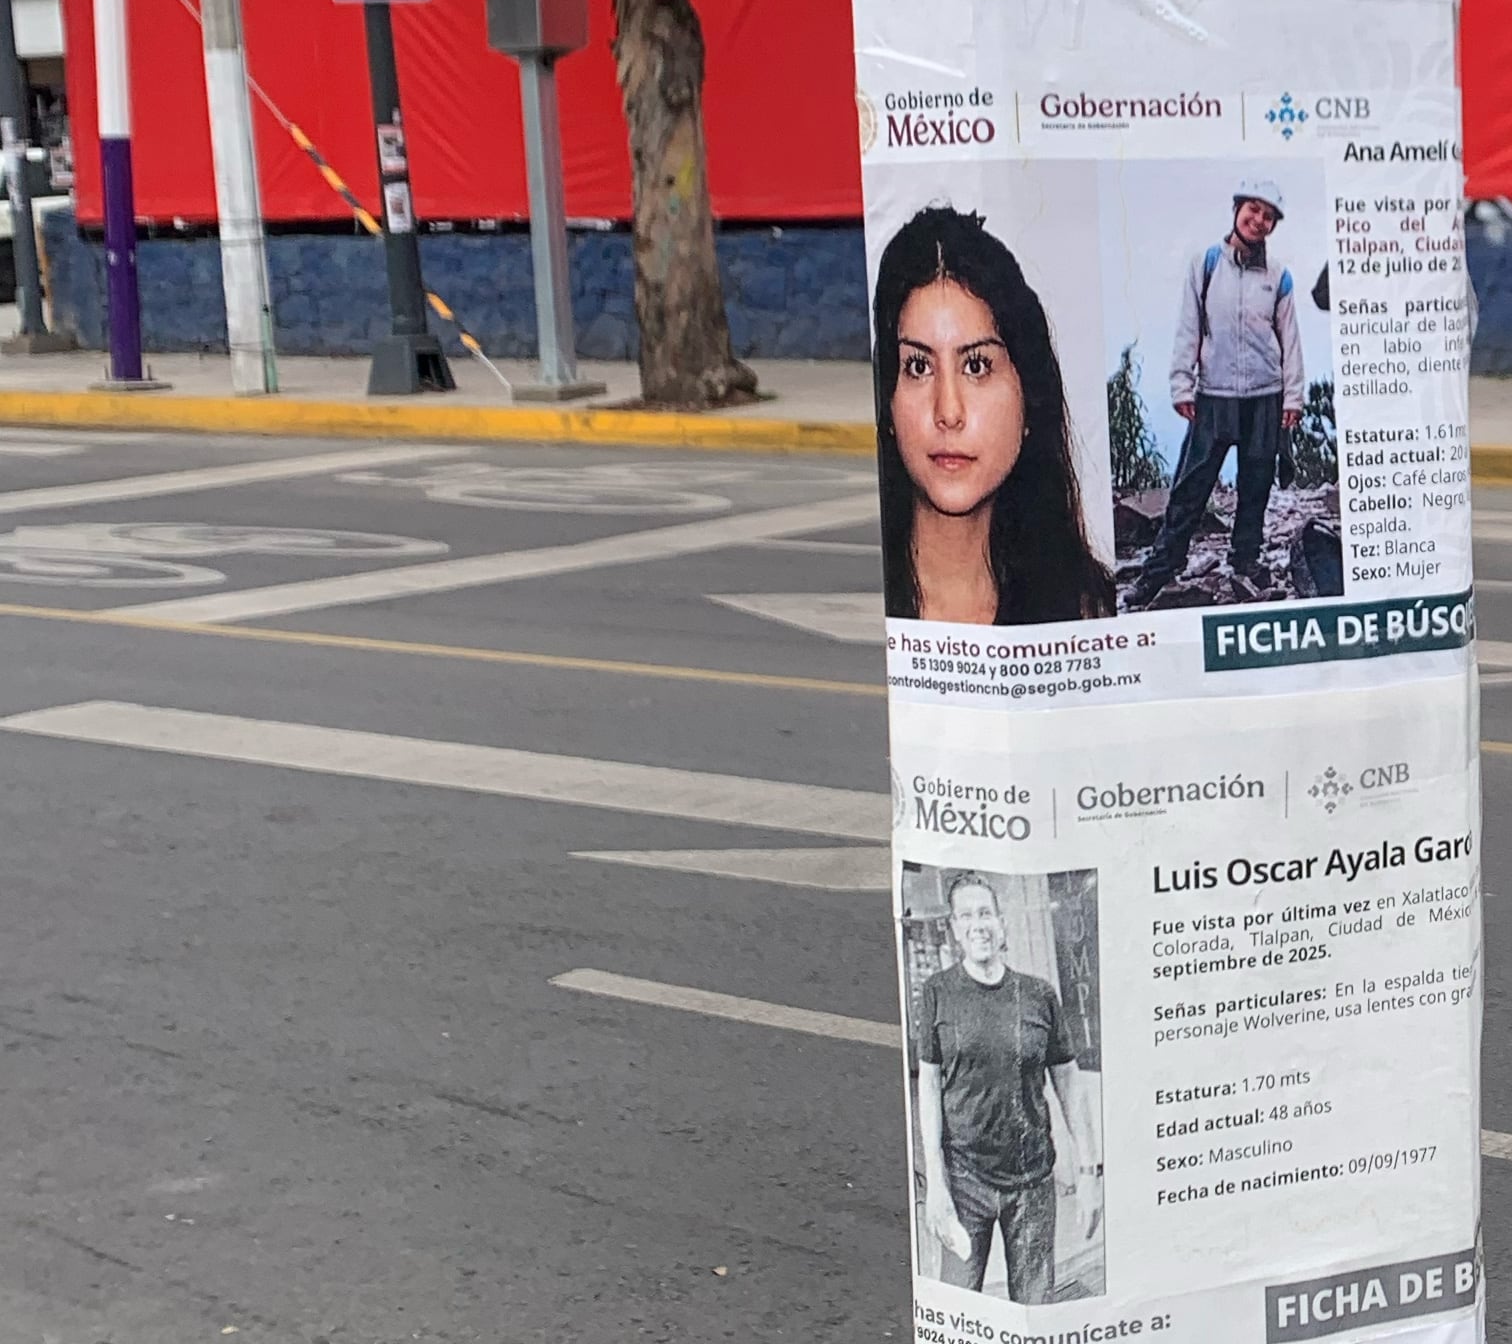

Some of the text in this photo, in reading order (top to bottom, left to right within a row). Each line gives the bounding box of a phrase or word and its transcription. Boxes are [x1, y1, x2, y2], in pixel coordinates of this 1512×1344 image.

[884, 87, 994, 112] Gobierno de
[1040, 90, 1222, 120] Gobernación
[1314, 97, 1371, 120] CNB
[886, 112, 995, 147] México
[1344, 139, 1447, 162] Ana Amelí
[1335, 196, 1451, 214] Fue vista por
[1338, 256, 1447, 277] 12 de julio de
[1342, 380, 1413, 396] astillado.
[1345, 428, 1419, 444] Estatura:
[1347, 447, 1445, 467] Edad actual:
[1350, 494, 1412, 512] Cabello:
[1350, 517, 1411, 538] espalda.
[1351, 540, 1435, 558] Tez: Blanca
[1352, 561, 1441, 581] Sexo: Mujer
[901, 629, 1156, 659] has visto comunícate a:
[1217, 613, 1378, 656] FICHA DE
[912, 775, 1031, 804] Gobierno de
[1359, 762, 1411, 790] CNB
[1076, 773, 1265, 811] Gobernación
[914, 797, 1032, 841] México
[1153, 841, 1406, 893] Luis Oscar Ayala
[1152, 900, 1370, 936] Fue vista por última vez
[1153, 944, 1332, 981] septiembre de 2025.
[1155, 1069, 1311, 1105] Estatura: 1.70 mts
[1156, 1100, 1332, 1139] Edad actual: 48 años
[1156, 1139, 1293, 1172] Sexo: Masculino
[1157, 1145, 1437, 1205] Fecha de nacimiento: 09/09/1977
[1277, 1270, 1444, 1328] FICHA DE
